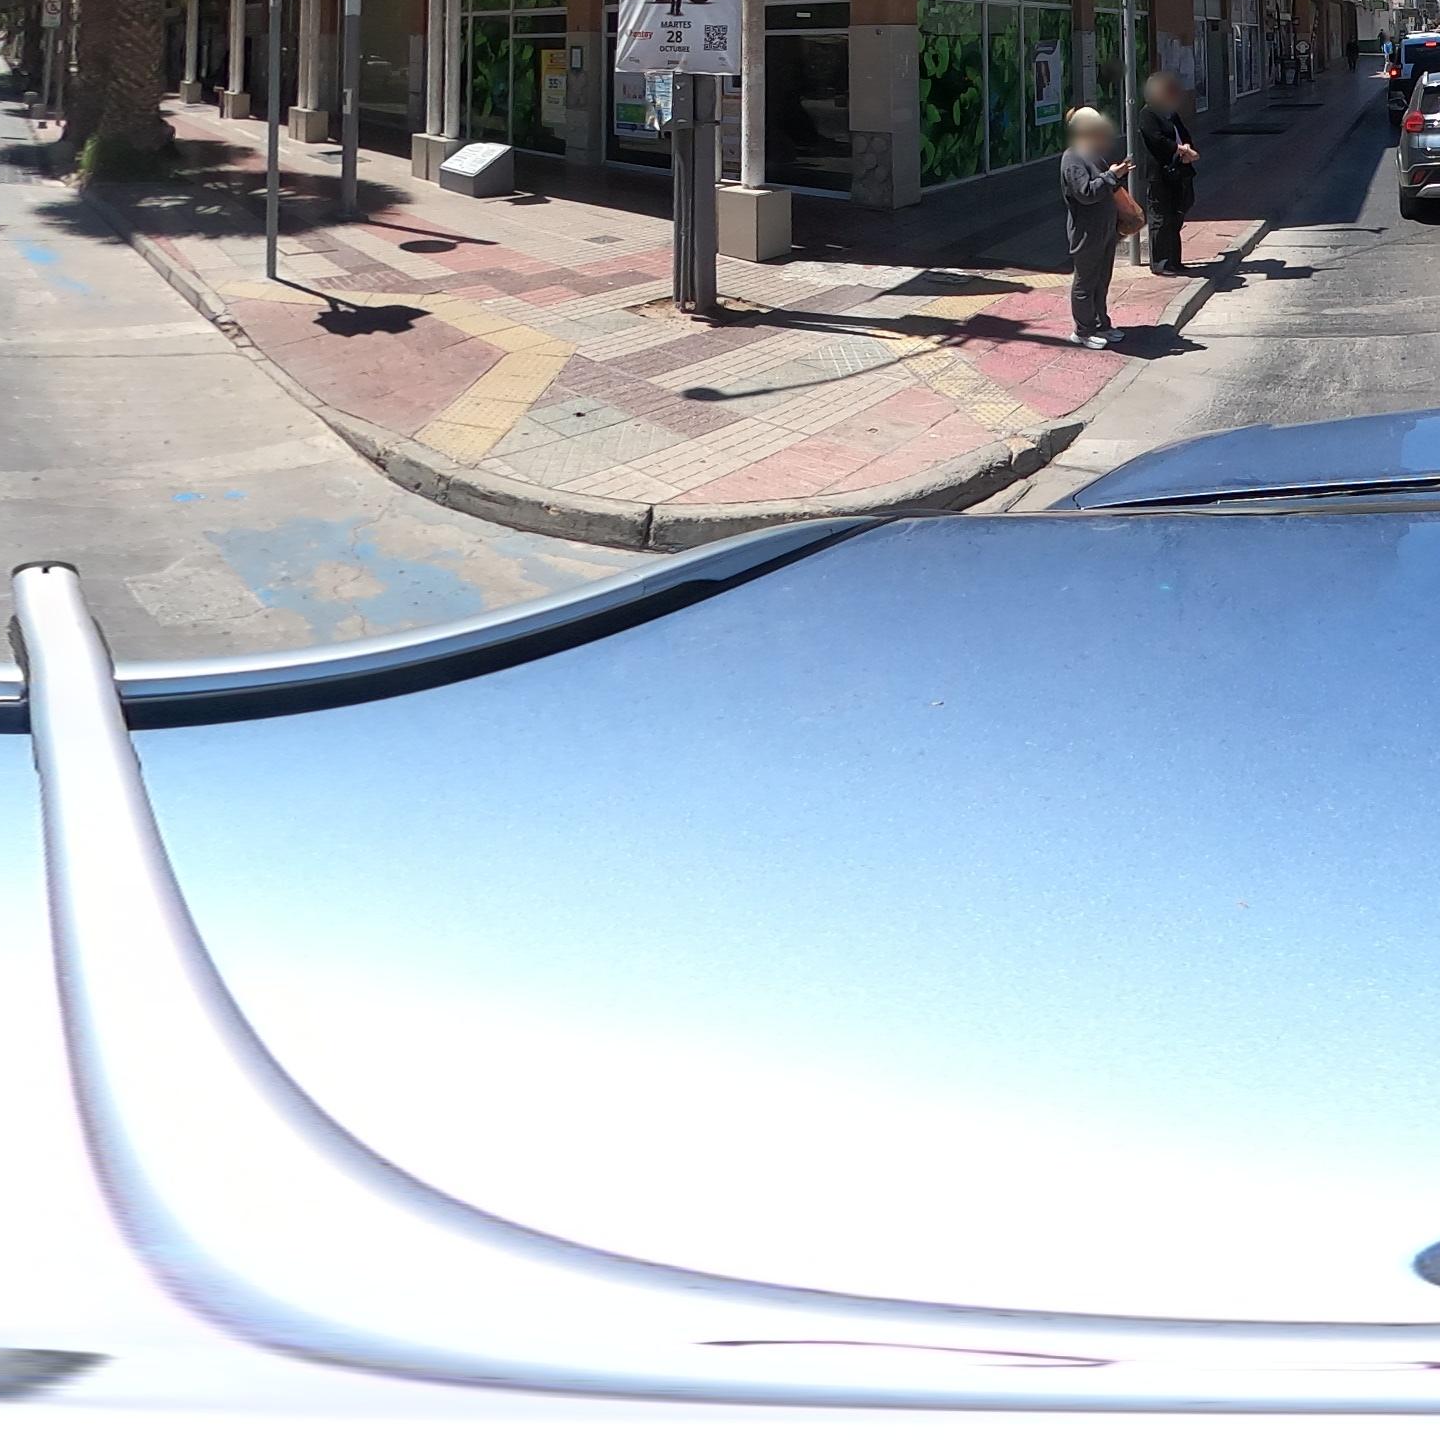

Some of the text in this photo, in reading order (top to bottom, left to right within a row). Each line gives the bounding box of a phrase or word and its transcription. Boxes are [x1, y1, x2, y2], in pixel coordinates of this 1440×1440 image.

[660, 21, 692, 29] MARTES
[666, 30, 683, 43] 28
[659, 45, 690, 53] OCTUBRE
